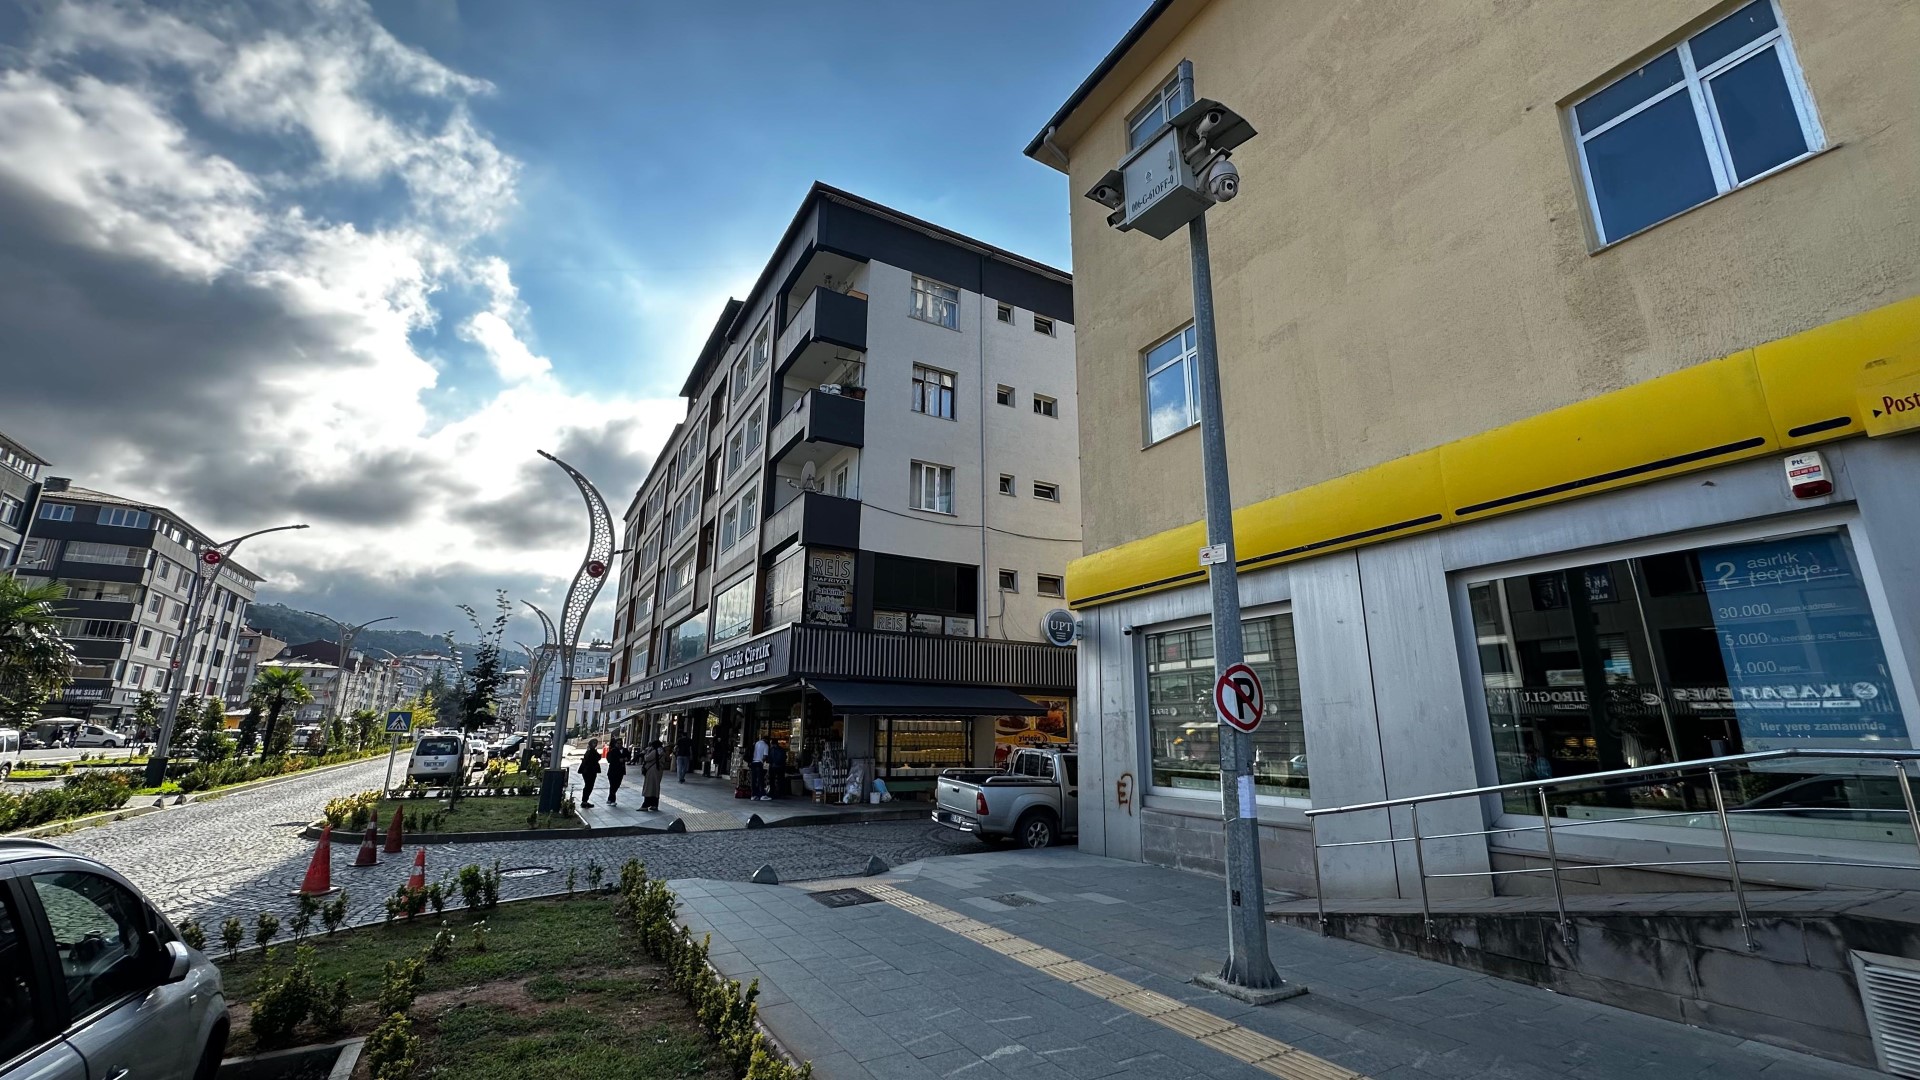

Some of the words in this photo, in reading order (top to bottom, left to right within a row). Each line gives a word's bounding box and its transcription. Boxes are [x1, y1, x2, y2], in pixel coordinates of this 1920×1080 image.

[1715, 561, 1739, 587] 2
[1719, 603, 1771, 619] 30.000
[1050, 620, 1072, 632] UPT
[1733, 660, 1777, 674] 4.000
[1760, 721, 1780, 731] Her
[1785, 723, 1811, 734] yere
